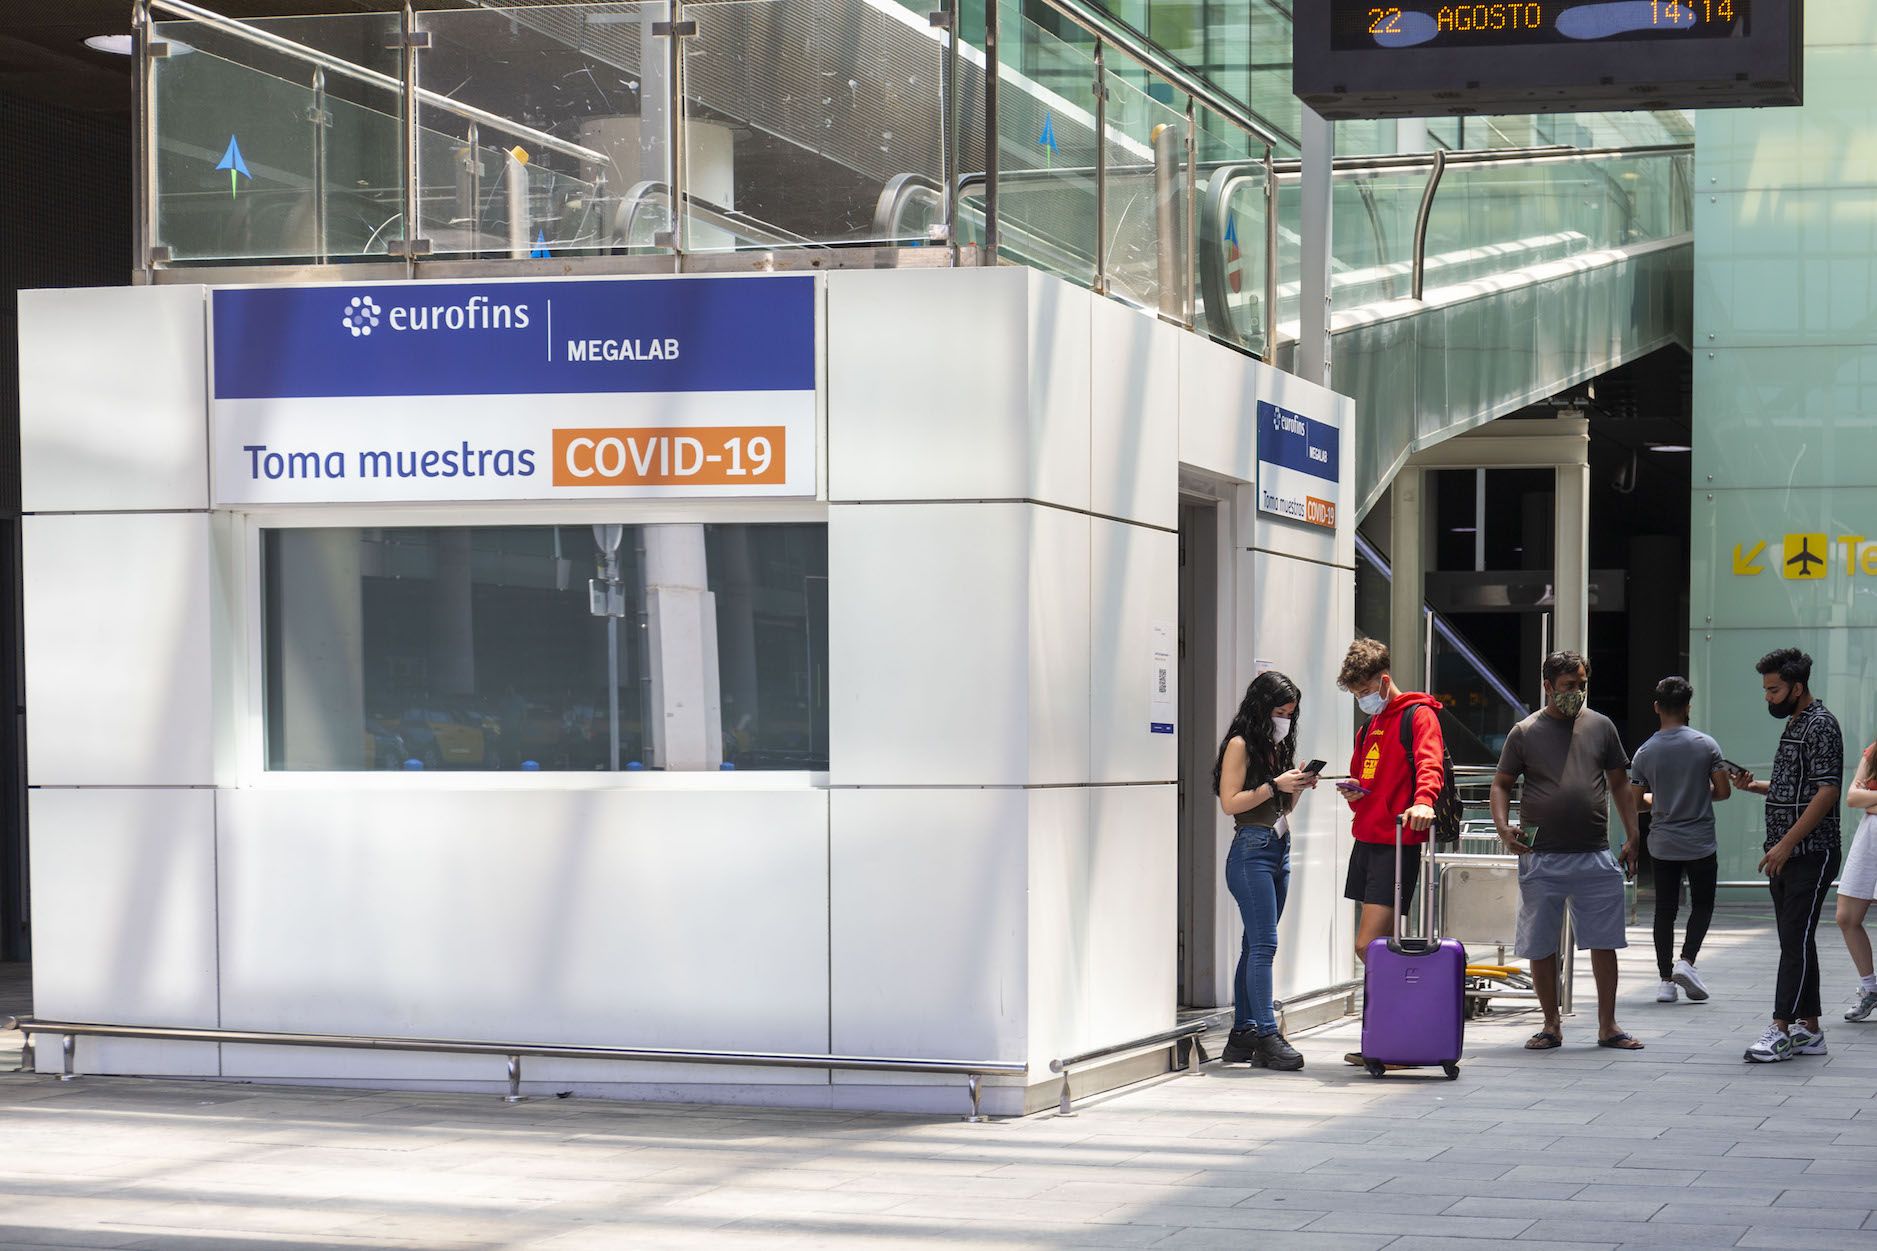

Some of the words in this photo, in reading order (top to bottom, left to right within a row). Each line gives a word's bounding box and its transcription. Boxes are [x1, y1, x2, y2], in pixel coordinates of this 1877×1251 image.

[1368, 7, 1402, 34] 22
[1437, 2, 1541, 32] AGOSTO
[1650, 0, 1734, 24] 14:14
[389, 295, 530, 331] eurofins
[567, 338, 680, 362] MEGALAB
[1281, 415, 1305, 436] eurofins
[243, 445, 346, 480] Toma
[358, 440, 535, 479] muestras
[565, 436, 772, 478] COVID-19
[1309, 446, 1328, 463] MEGALAB
[1263, 490, 1278, 511] Toma
[1279, 497, 1305, 517] muestras
[1307, 500, 1334, 525] COVID-19
